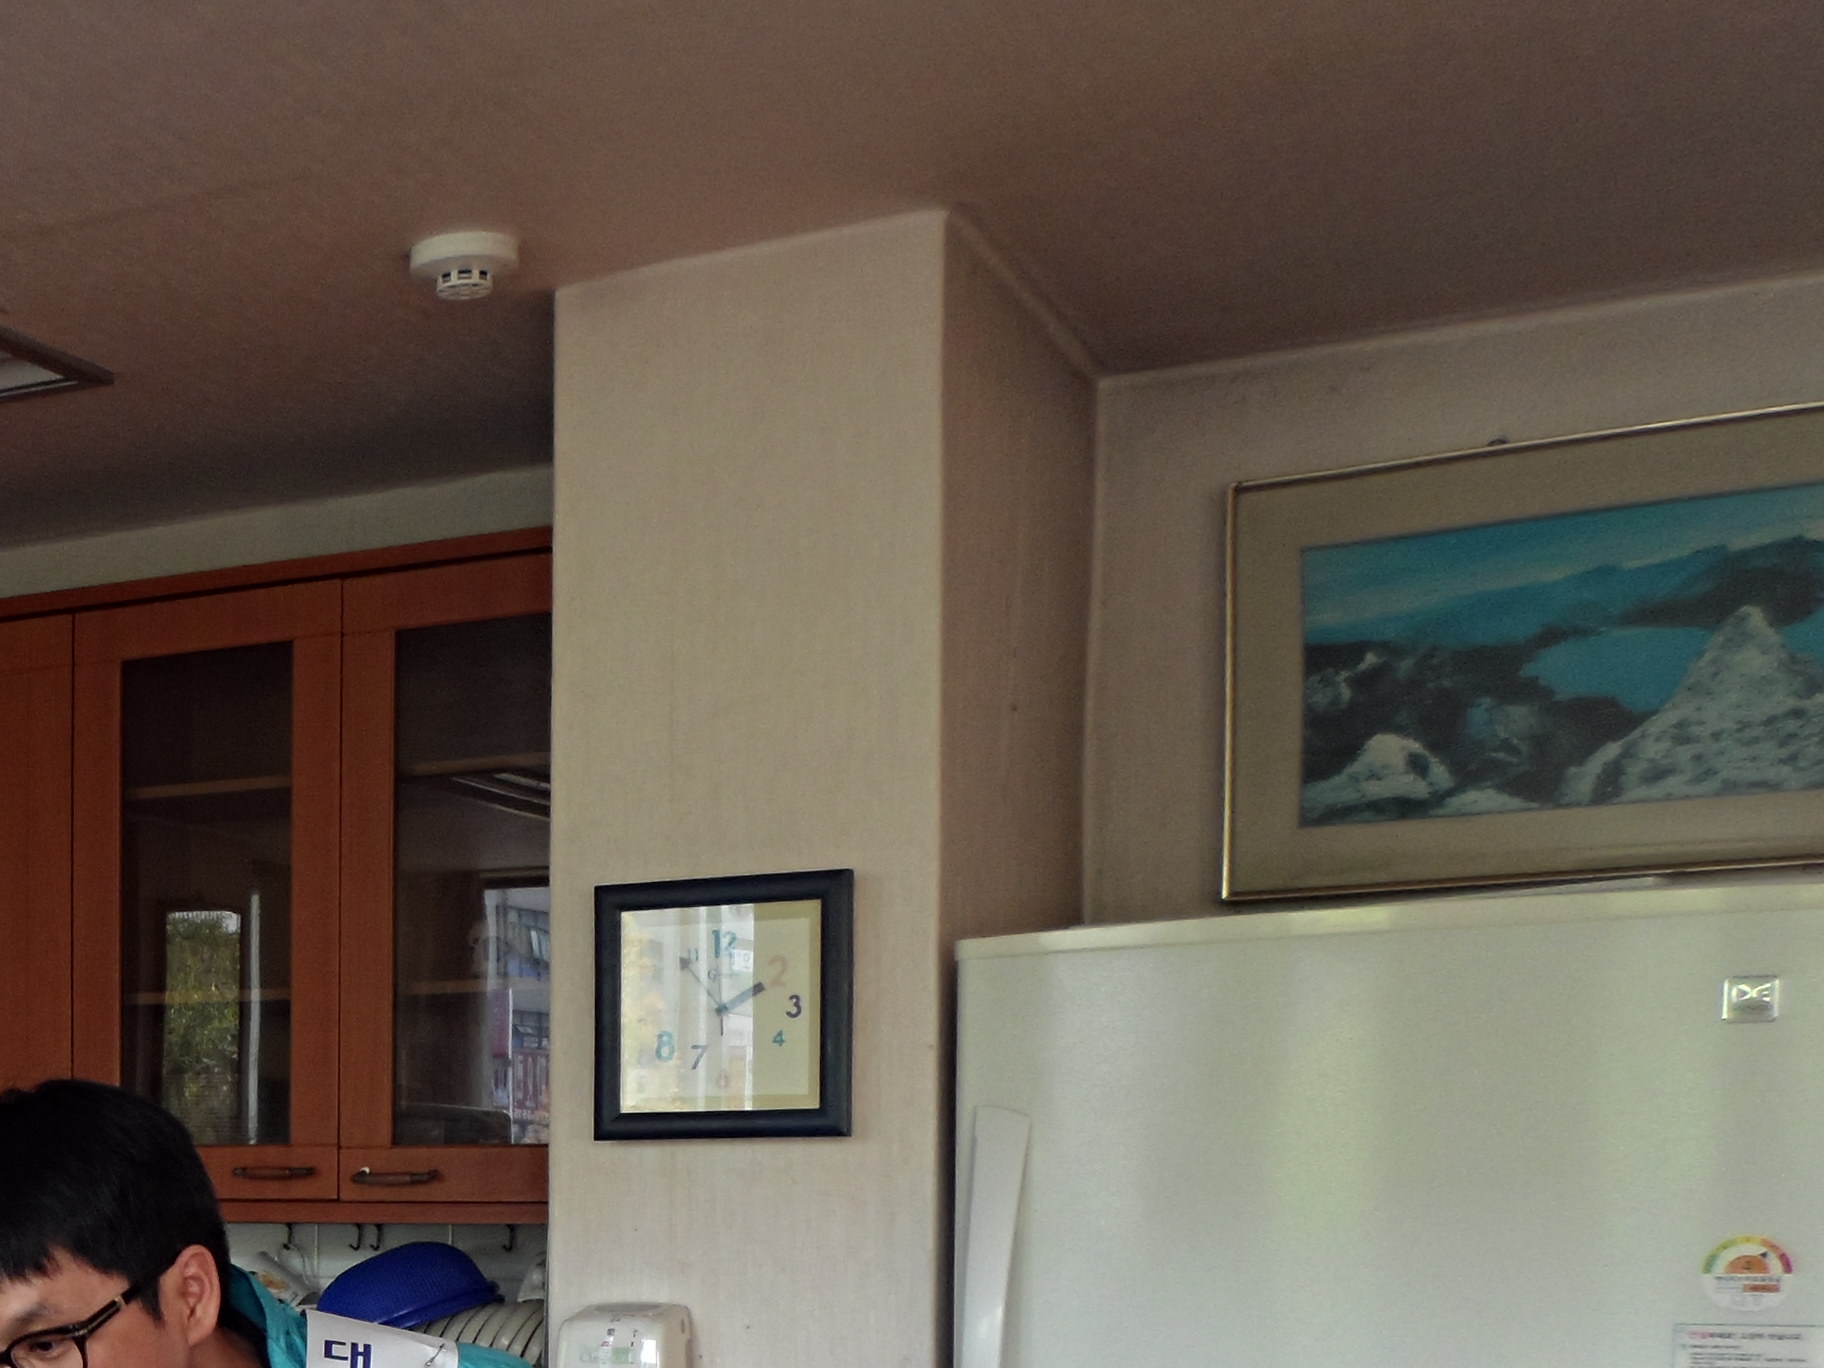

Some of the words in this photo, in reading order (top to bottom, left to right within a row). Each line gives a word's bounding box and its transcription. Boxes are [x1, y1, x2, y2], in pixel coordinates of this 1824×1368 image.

[768, 954, 789, 989] 2
[786, 994, 803, 1019] 3
[655, 1030, 676, 1062] 8
[772, 1029, 786, 1048] 4
[691, 1044, 709, 1071] 7
